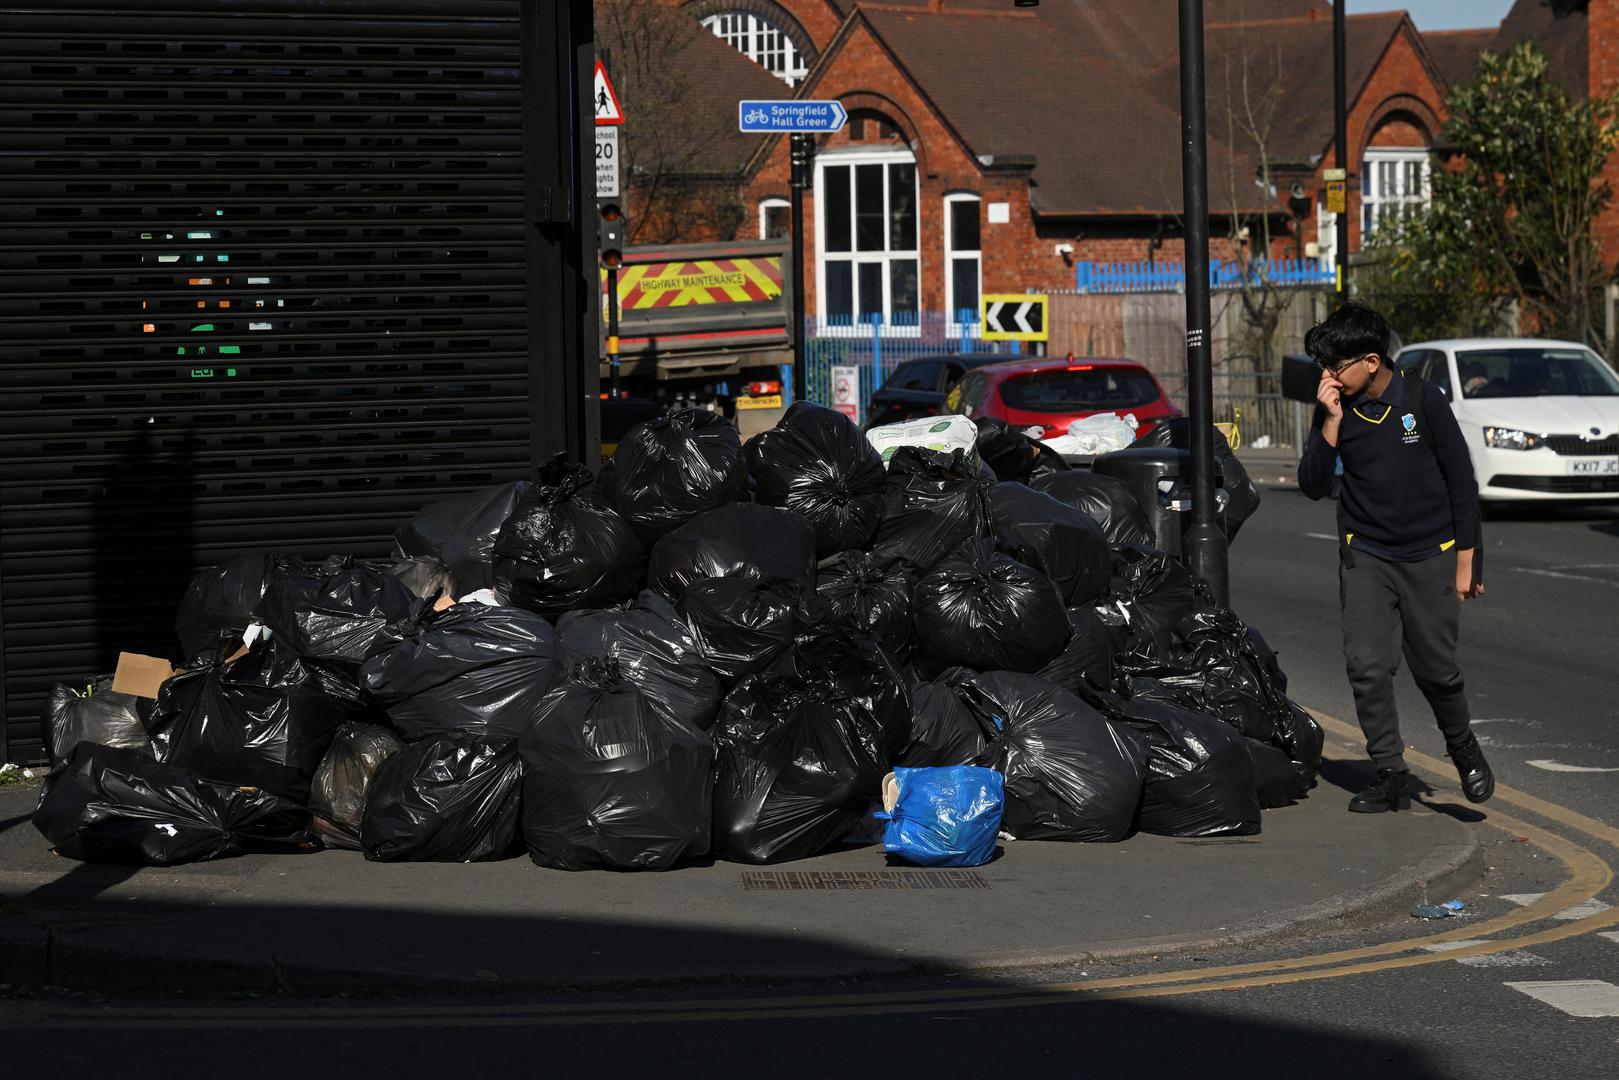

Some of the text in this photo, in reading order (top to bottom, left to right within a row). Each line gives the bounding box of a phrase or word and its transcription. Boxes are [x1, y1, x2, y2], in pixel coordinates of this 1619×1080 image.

[771, 105, 827, 116] Springfield
[772, 117, 827, 126] Hall Green
[596, 131, 616, 139] chool
[595, 143, 613, 159] 20
[597, 174, 614, 183] ights
[642, 273, 743, 290] HIGHWAY MAINTENANCE
[1573, 460, 1600, 472] KX17
